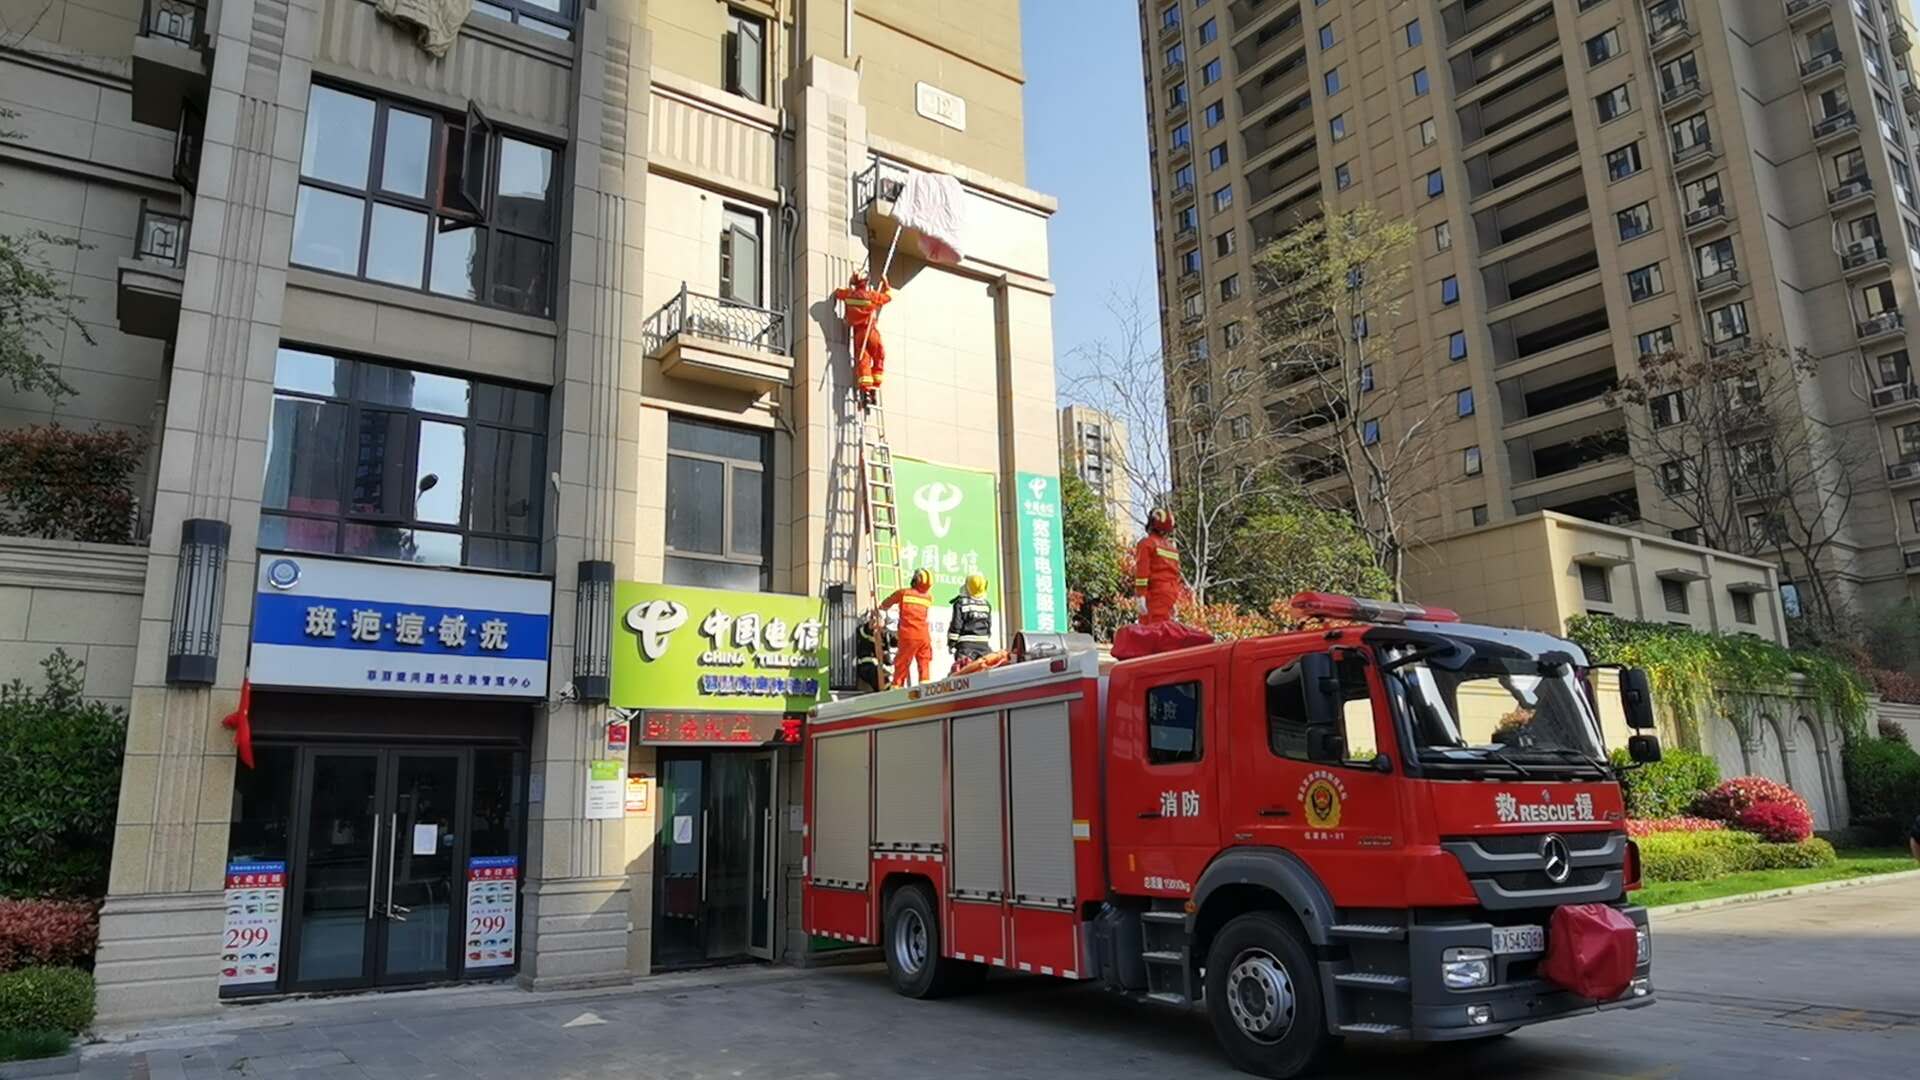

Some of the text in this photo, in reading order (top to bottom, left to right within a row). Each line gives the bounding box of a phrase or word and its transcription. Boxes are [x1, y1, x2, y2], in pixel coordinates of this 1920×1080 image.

[901, 540, 979, 573] 中国电信
[702, 608, 822, 652] 中国电信
[702, 651, 819, 669] CHINA TELECOM
[925, 678, 969, 696] ZOOMLION
[1160, 790, 1200, 816] 消防
[1495, 793, 1518, 821] 救
[1519, 804, 1575, 821] RESCUE
[1575, 793, 1594, 820] 援
[470, 915, 505, 935] 299
[224, 926, 269, 949] 299
